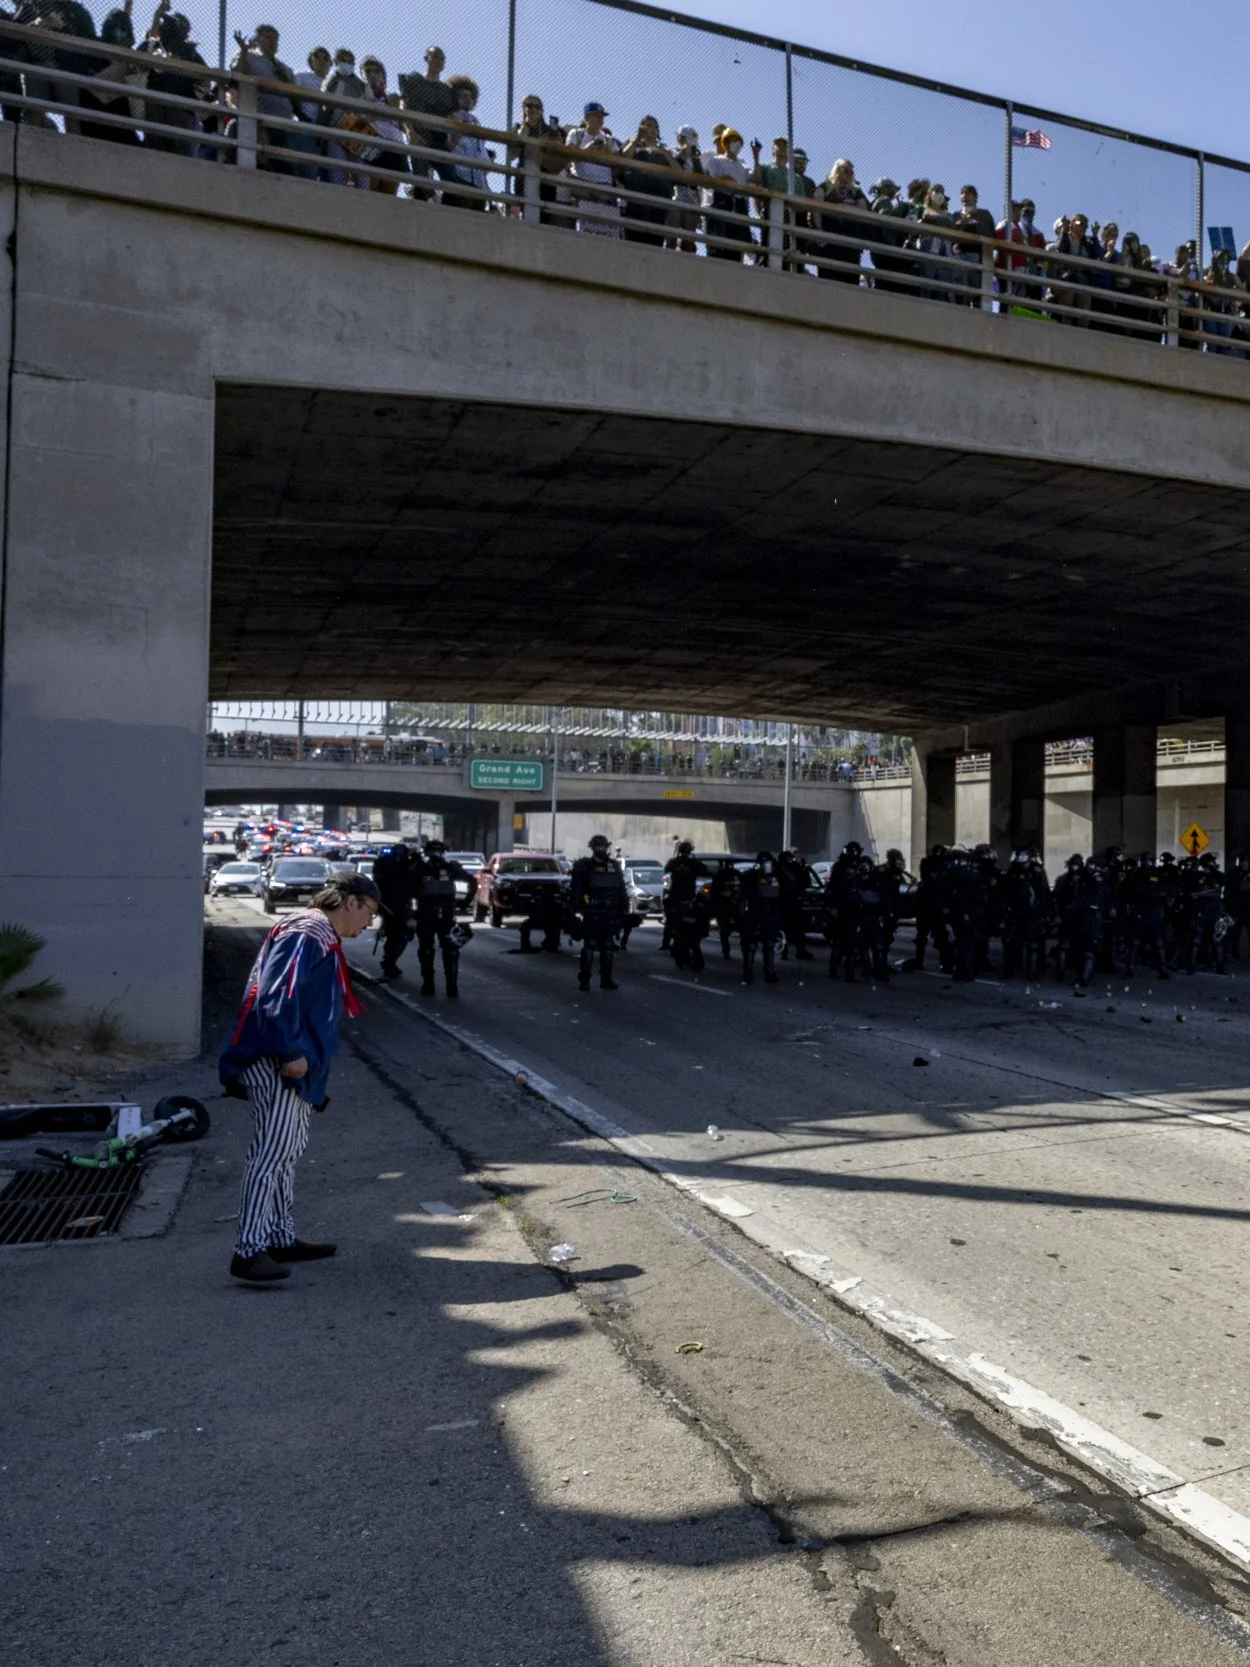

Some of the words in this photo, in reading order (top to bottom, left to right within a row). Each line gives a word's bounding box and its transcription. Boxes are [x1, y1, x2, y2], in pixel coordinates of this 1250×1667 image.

[479, 764, 511, 774] Grand
[516, 766, 535, 775] Ave
[478, 776, 510, 785] SECOND
[512, 777, 536, 785] RIGHT
